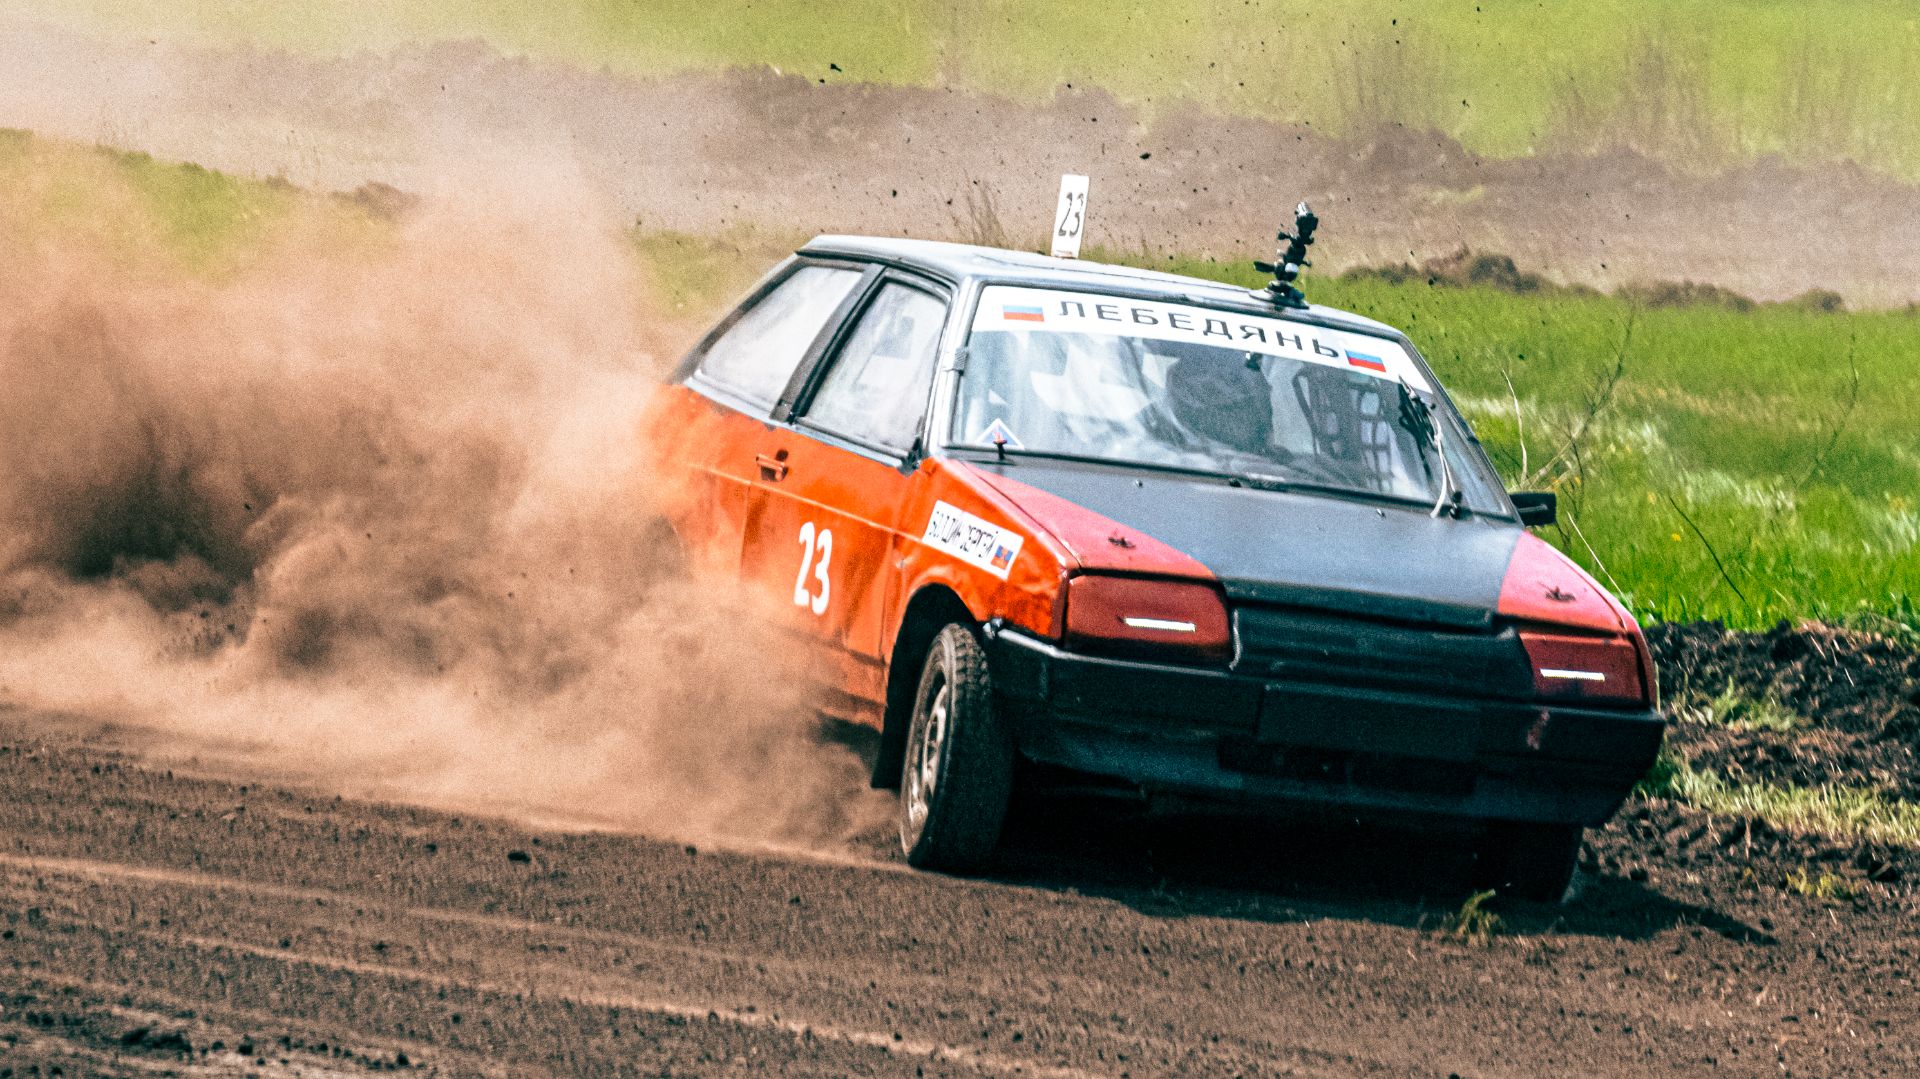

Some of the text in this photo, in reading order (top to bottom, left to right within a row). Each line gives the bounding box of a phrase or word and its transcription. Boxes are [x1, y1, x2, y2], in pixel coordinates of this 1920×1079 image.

[1058, 192, 1084, 238] 23
[1059, 300, 1339, 358] ЛЕБЕДЯНЬ
[793, 521, 833, 616] 23
